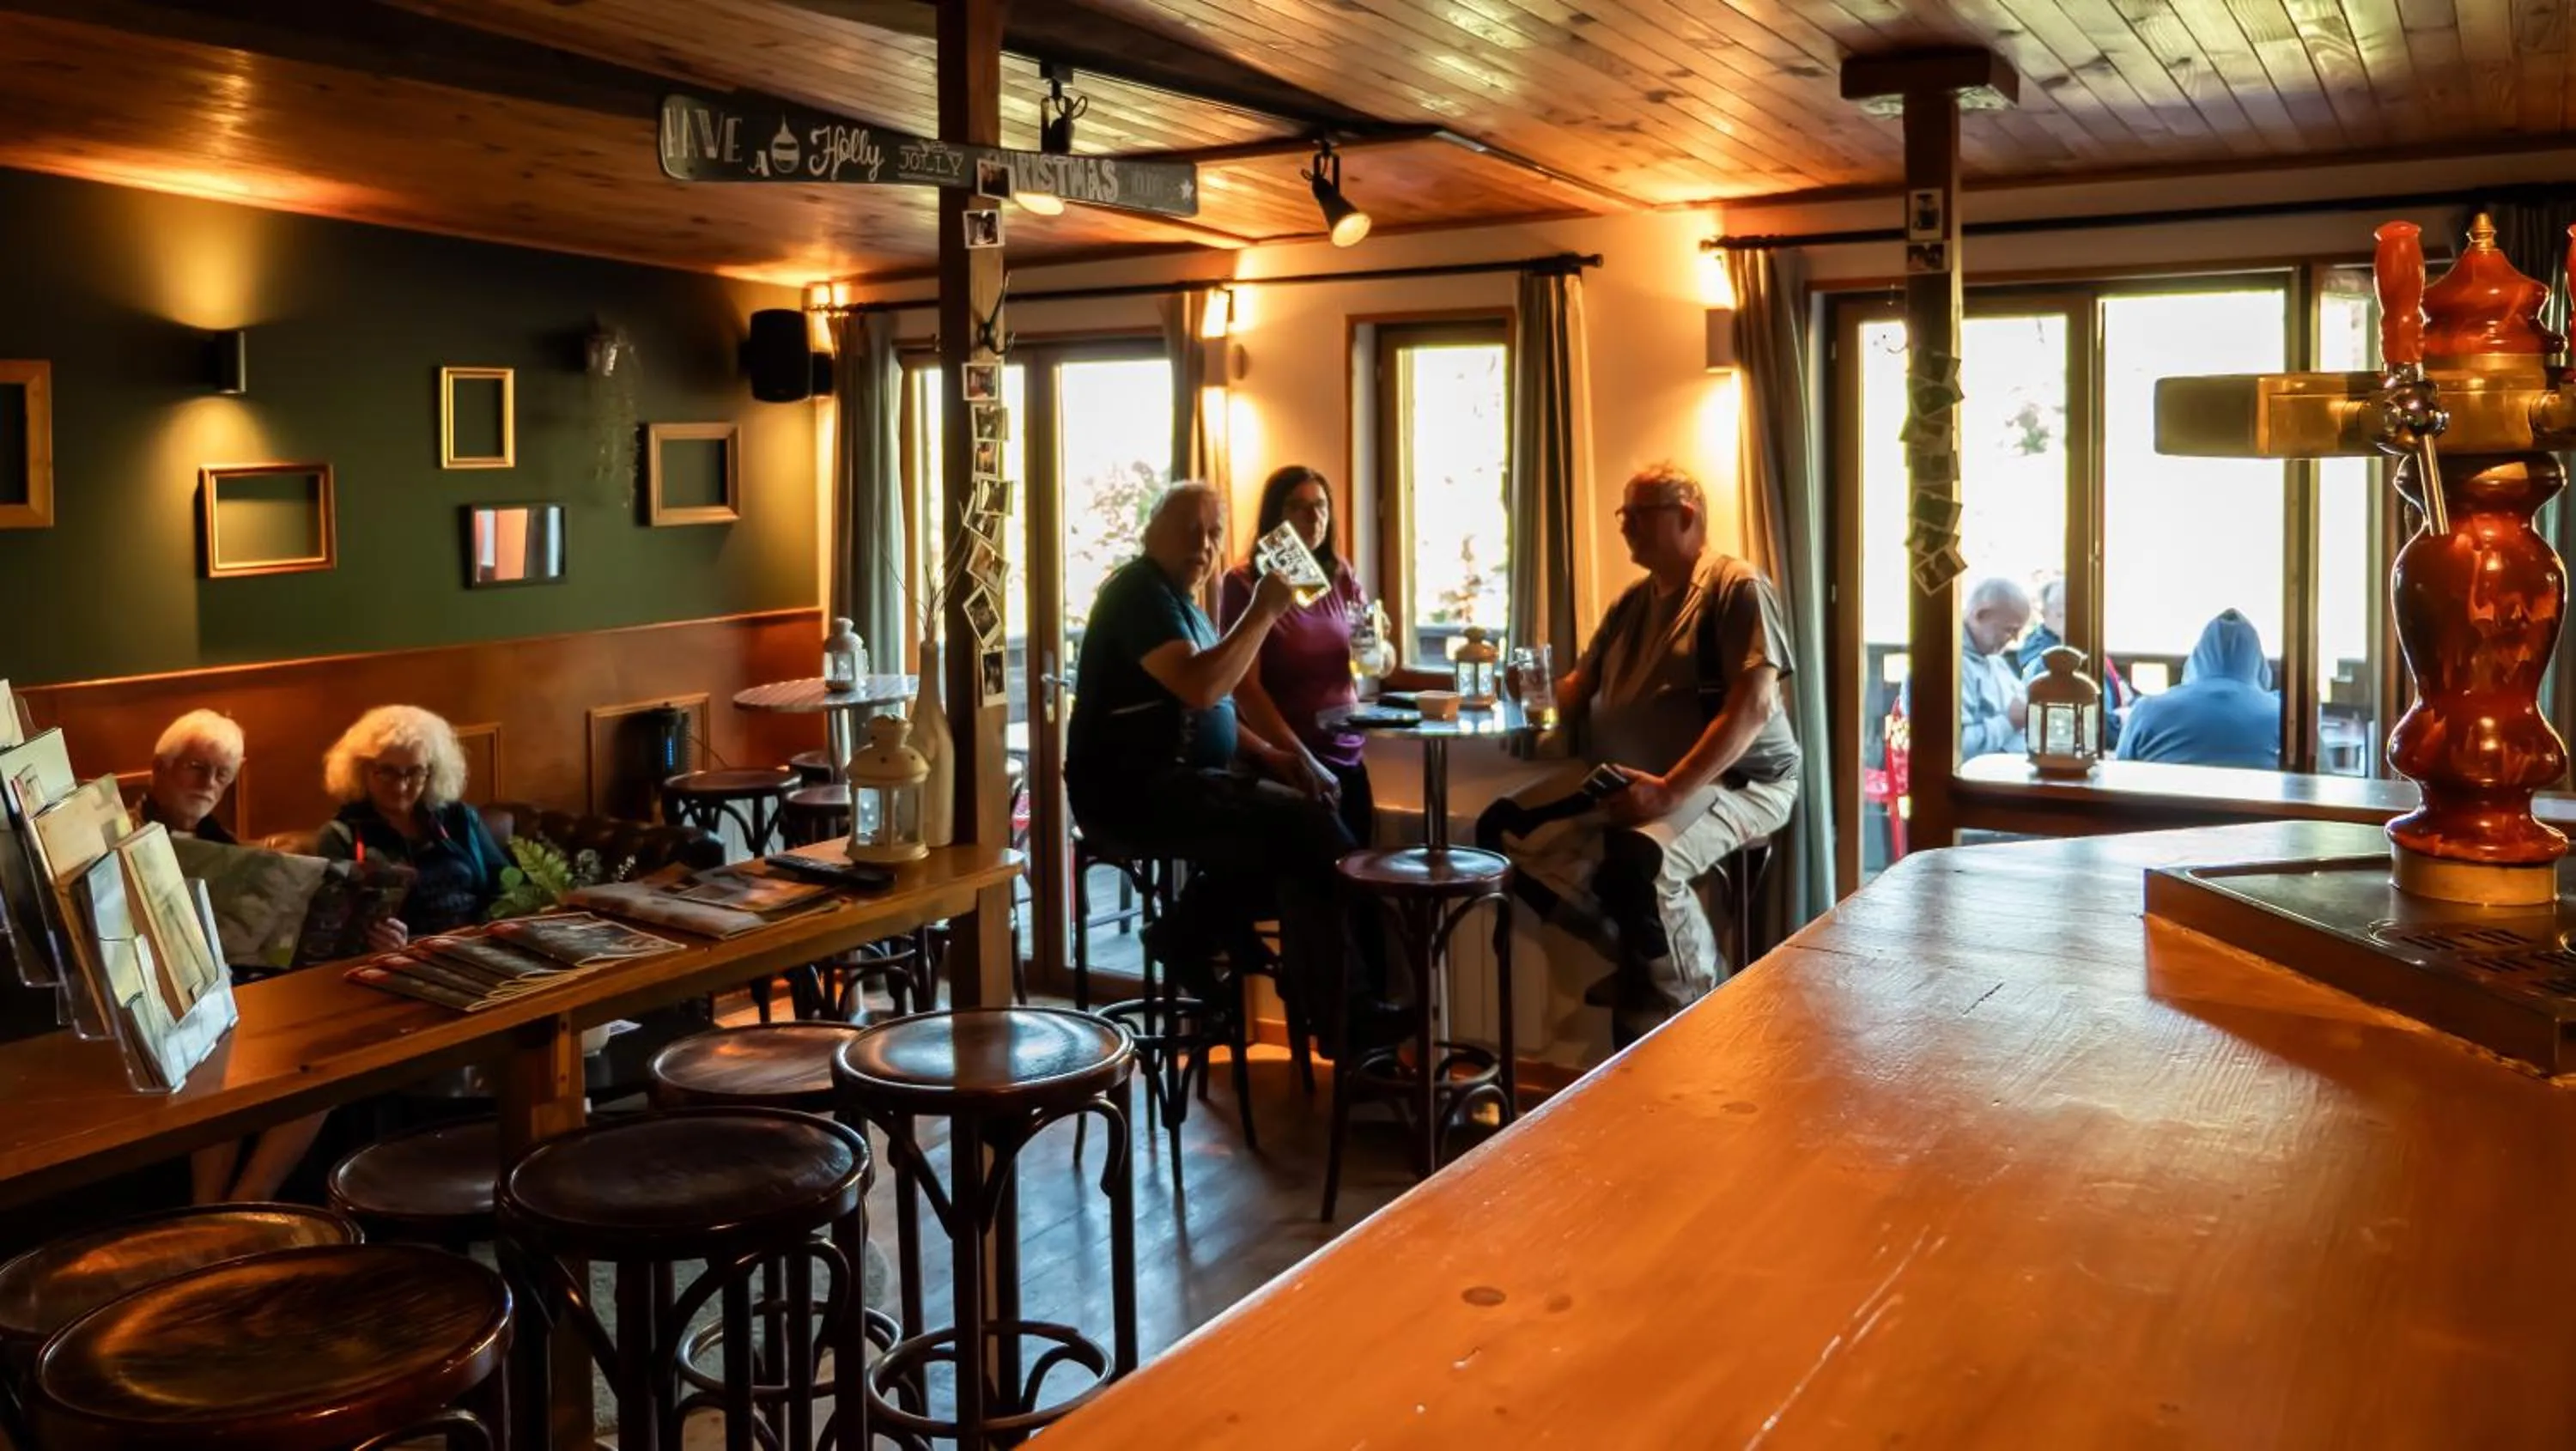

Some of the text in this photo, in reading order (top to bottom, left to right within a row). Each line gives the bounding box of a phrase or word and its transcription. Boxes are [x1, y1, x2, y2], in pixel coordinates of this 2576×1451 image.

[747, 149, 771, 177] A
[809, 125, 885, 182] Holly
[898, 149, 964, 177] JOLLY
[987, 149, 1120, 203] RISTMAS
